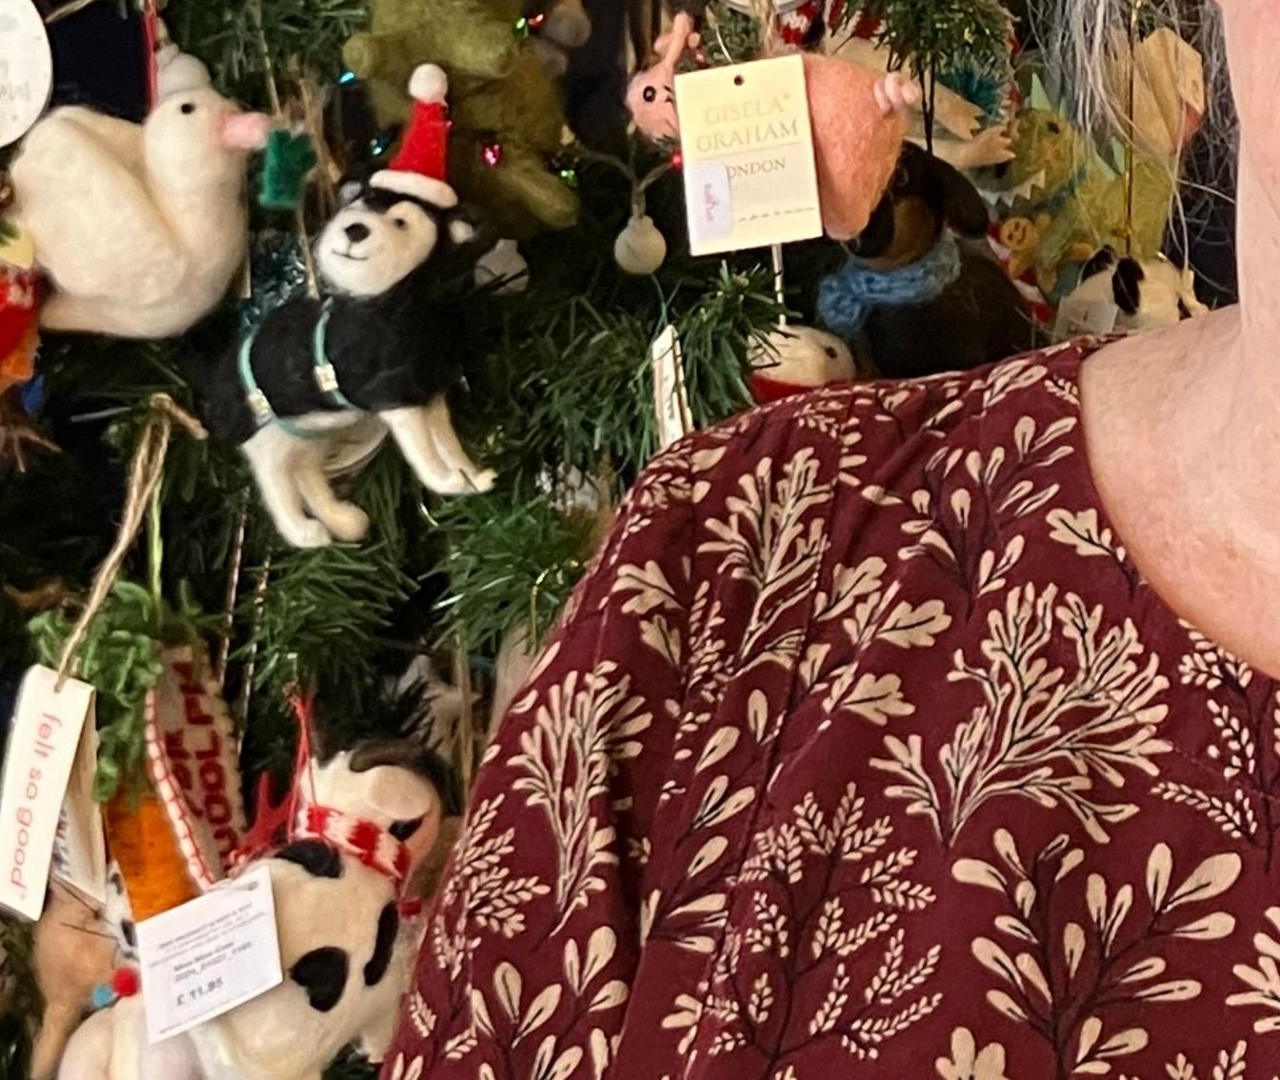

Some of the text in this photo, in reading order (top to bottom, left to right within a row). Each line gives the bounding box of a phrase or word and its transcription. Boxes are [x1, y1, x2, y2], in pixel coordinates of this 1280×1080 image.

[695, 119, 799, 152] GRAHAM
[726, 156, 788, 180] ONDON
[33, 712, 63, 759] felt
[25, 766, 42, 801] so
